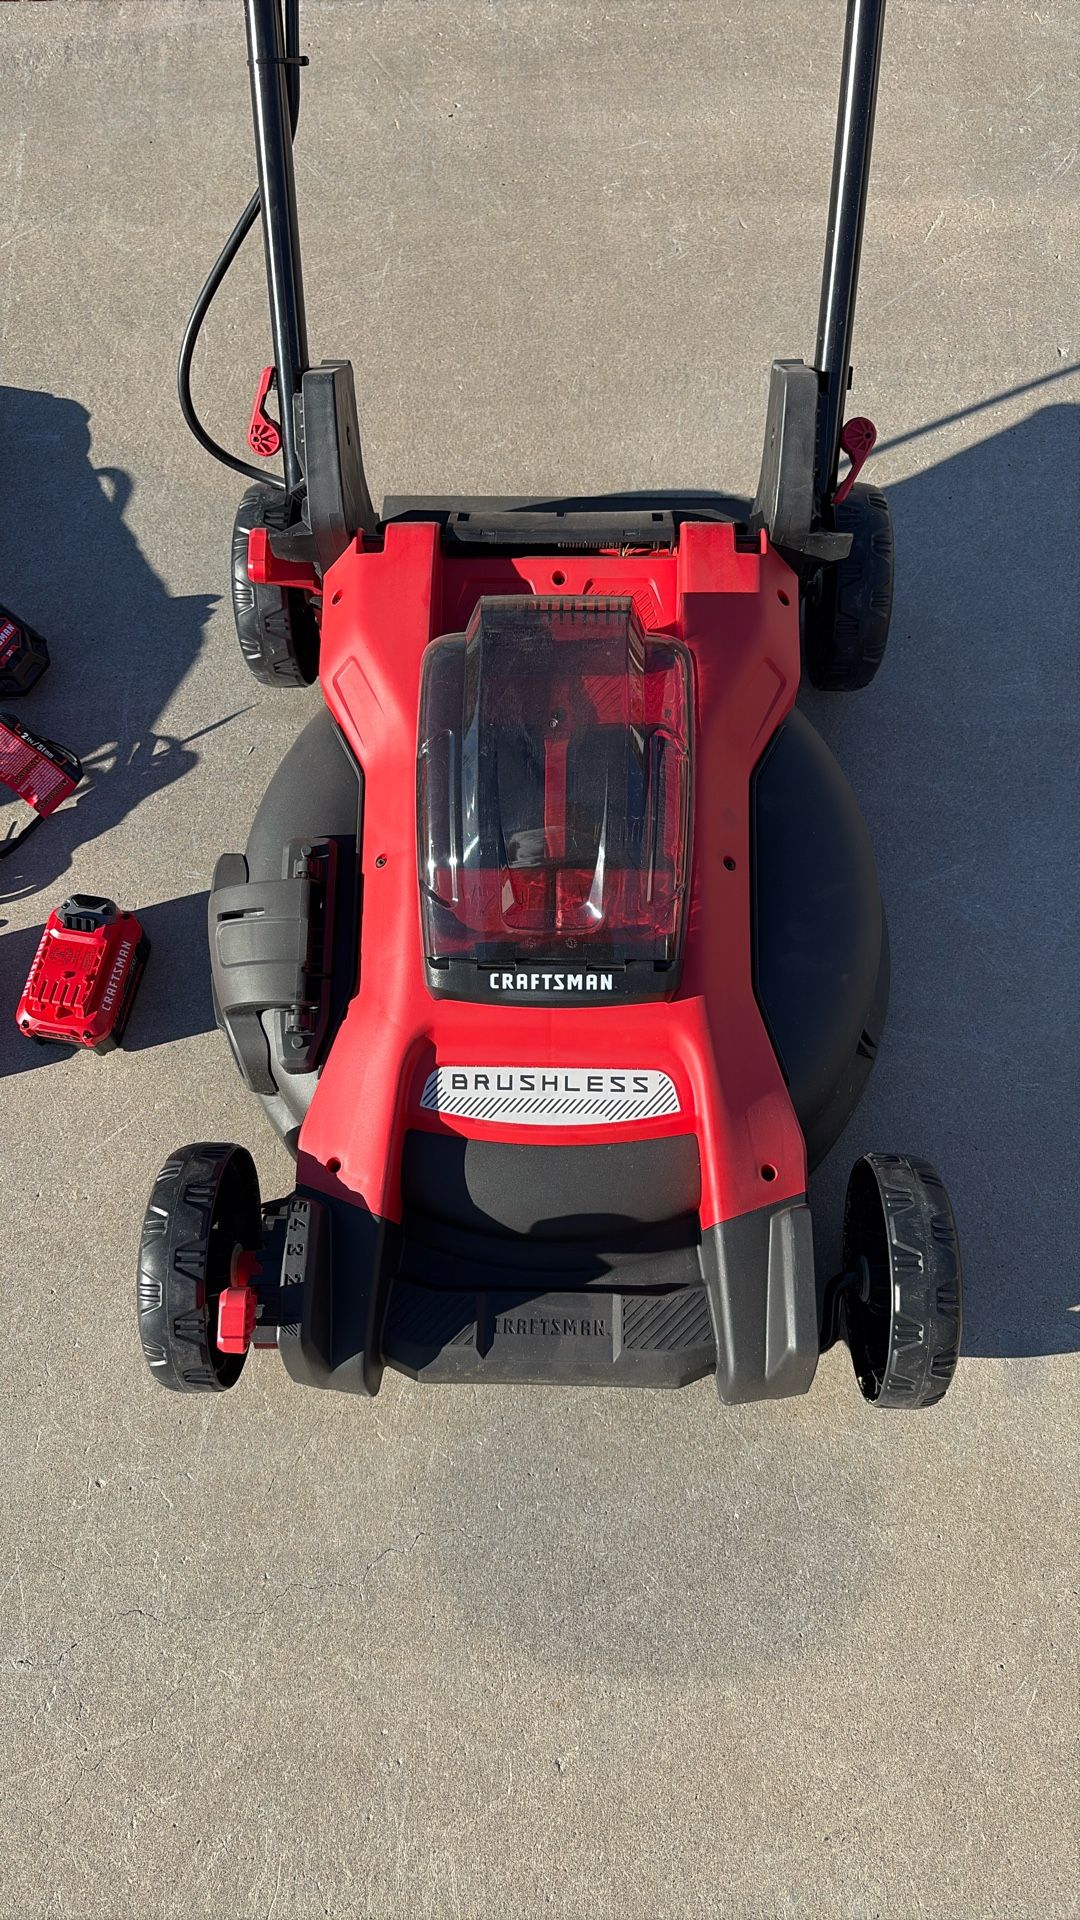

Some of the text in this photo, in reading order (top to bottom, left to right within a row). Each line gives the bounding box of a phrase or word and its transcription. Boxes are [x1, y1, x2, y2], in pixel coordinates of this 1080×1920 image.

[101, 940, 132, 1011] CRAFTSMAN
[489, 972, 613, 991] CRAFTSMAN
[451, 1073, 649, 1093] BRUSHLESS
[291, 1201, 308, 1213] 5
[289, 1218, 306, 1232] 4
[287, 1243, 304, 1256] 3
